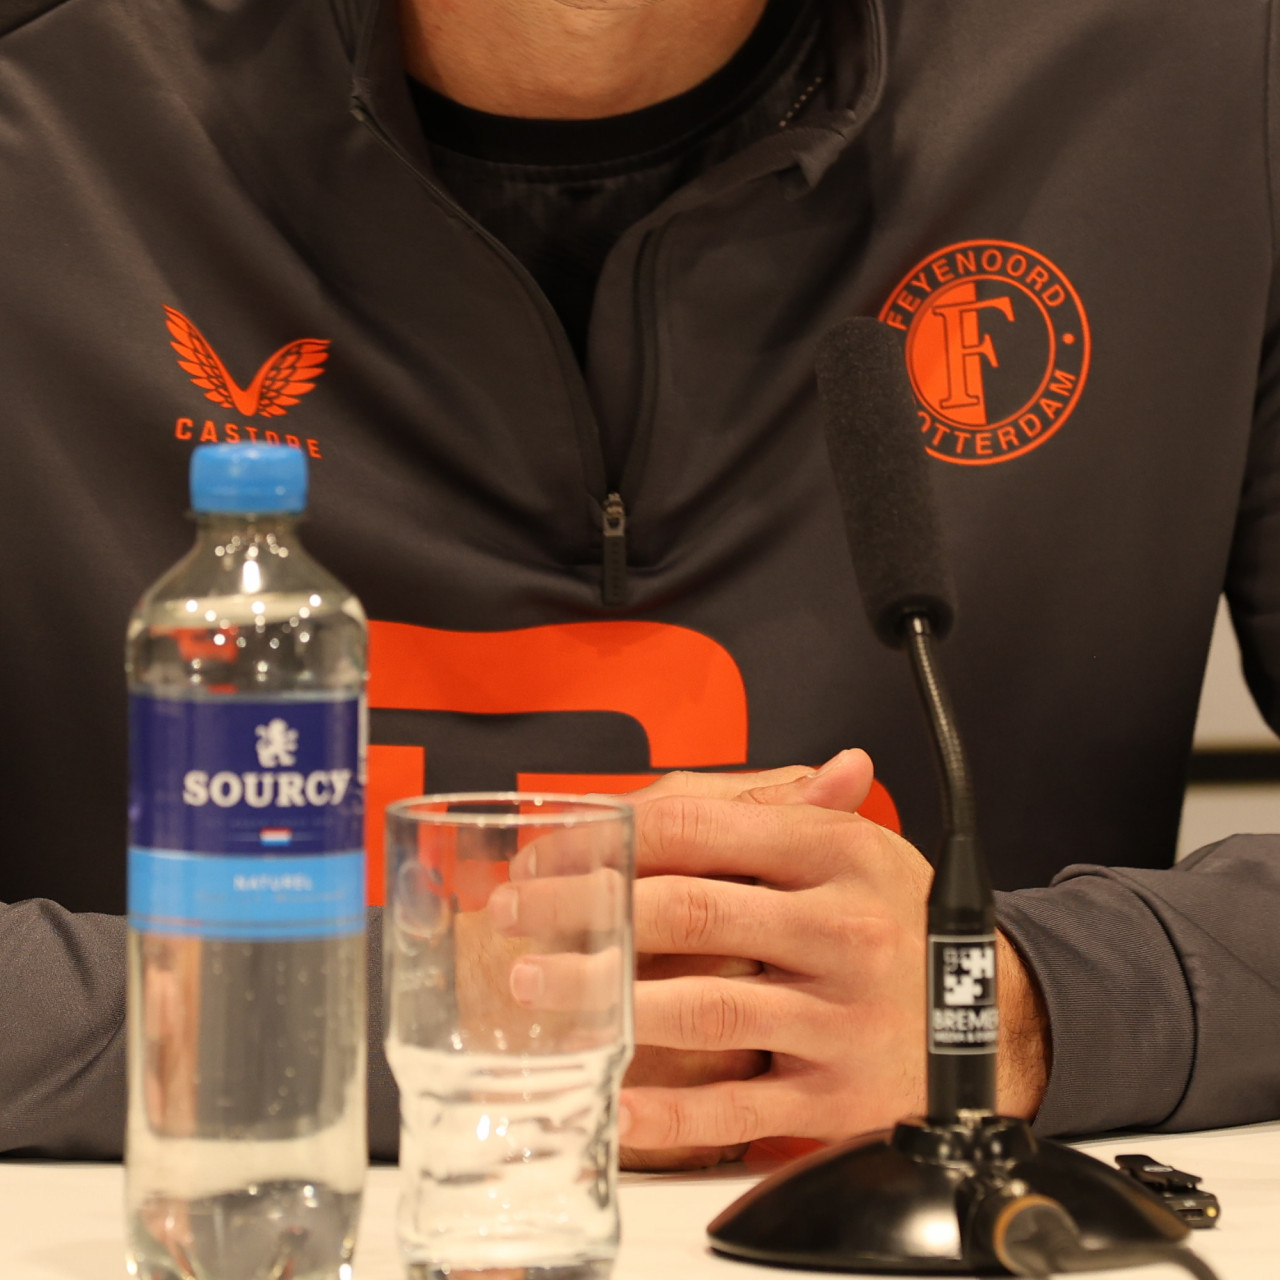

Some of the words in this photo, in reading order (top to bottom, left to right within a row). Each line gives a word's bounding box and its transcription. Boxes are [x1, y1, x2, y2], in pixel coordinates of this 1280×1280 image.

[886, 248, 1067, 332] FEYENOORD
[917, 369, 1077, 455] OTTERDAM
[182, 769, 352, 808] SOURCY
